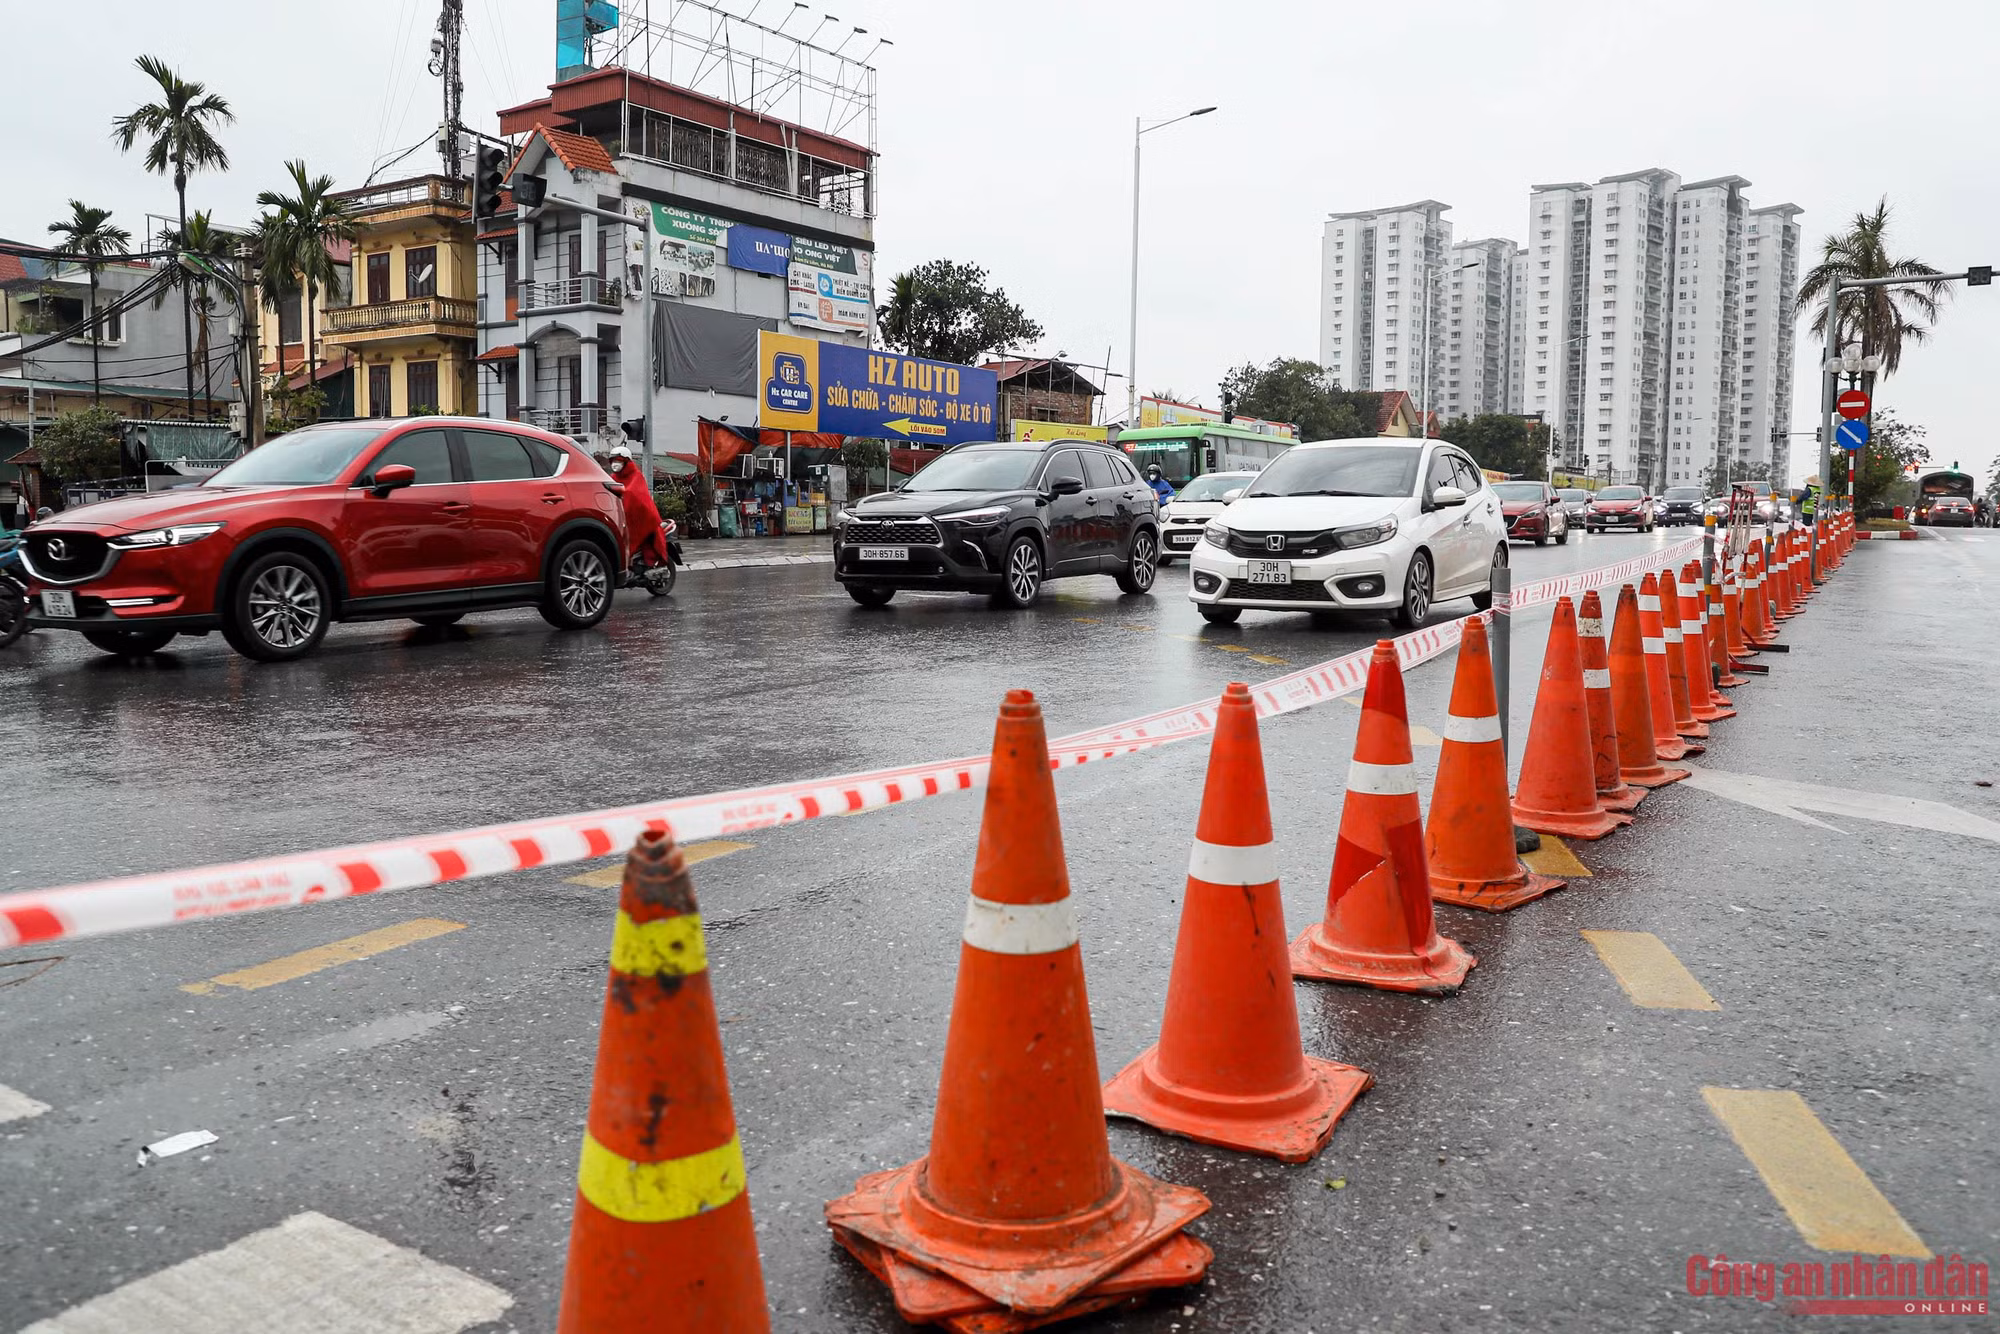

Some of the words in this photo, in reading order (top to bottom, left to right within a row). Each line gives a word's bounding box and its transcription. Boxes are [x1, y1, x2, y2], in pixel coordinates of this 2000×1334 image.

[661, 206, 690, 219] CÔNG
[693, 213, 706, 223] TY
[709, 217, 734, 228] TNHH
[815, 241, 829, 251] LED
[831, 244, 848, 256] VIỆT
[804, 249, 822, 259] ONG
[824, 252, 841, 263] VIỆT
[868, 354, 898, 387] HZ
[902, 360, 960, 396] AUTO
[780, 388, 792, 398] CAR
[793, 389, 808, 400] CARE
[782, 398, 798, 406] CENTRE
[827, 380, 849, 407] SỬA
[851, 387, 879, 411] CHỮA
[888, 391, 917, 416] CHĂM
[919, 395, 938, 418] SÓC
[945, 398, 958, 424] ĐỘ
[960, 403, 971, 422] XE
[973, 401, 979, 423] Ô
[981, 403, 991, 424] TÔ
[921, 425, 932, 433] VÀO
[1260, 561, 1279, 572] 30H
[1252, 572, 1287, 583] 271.83
